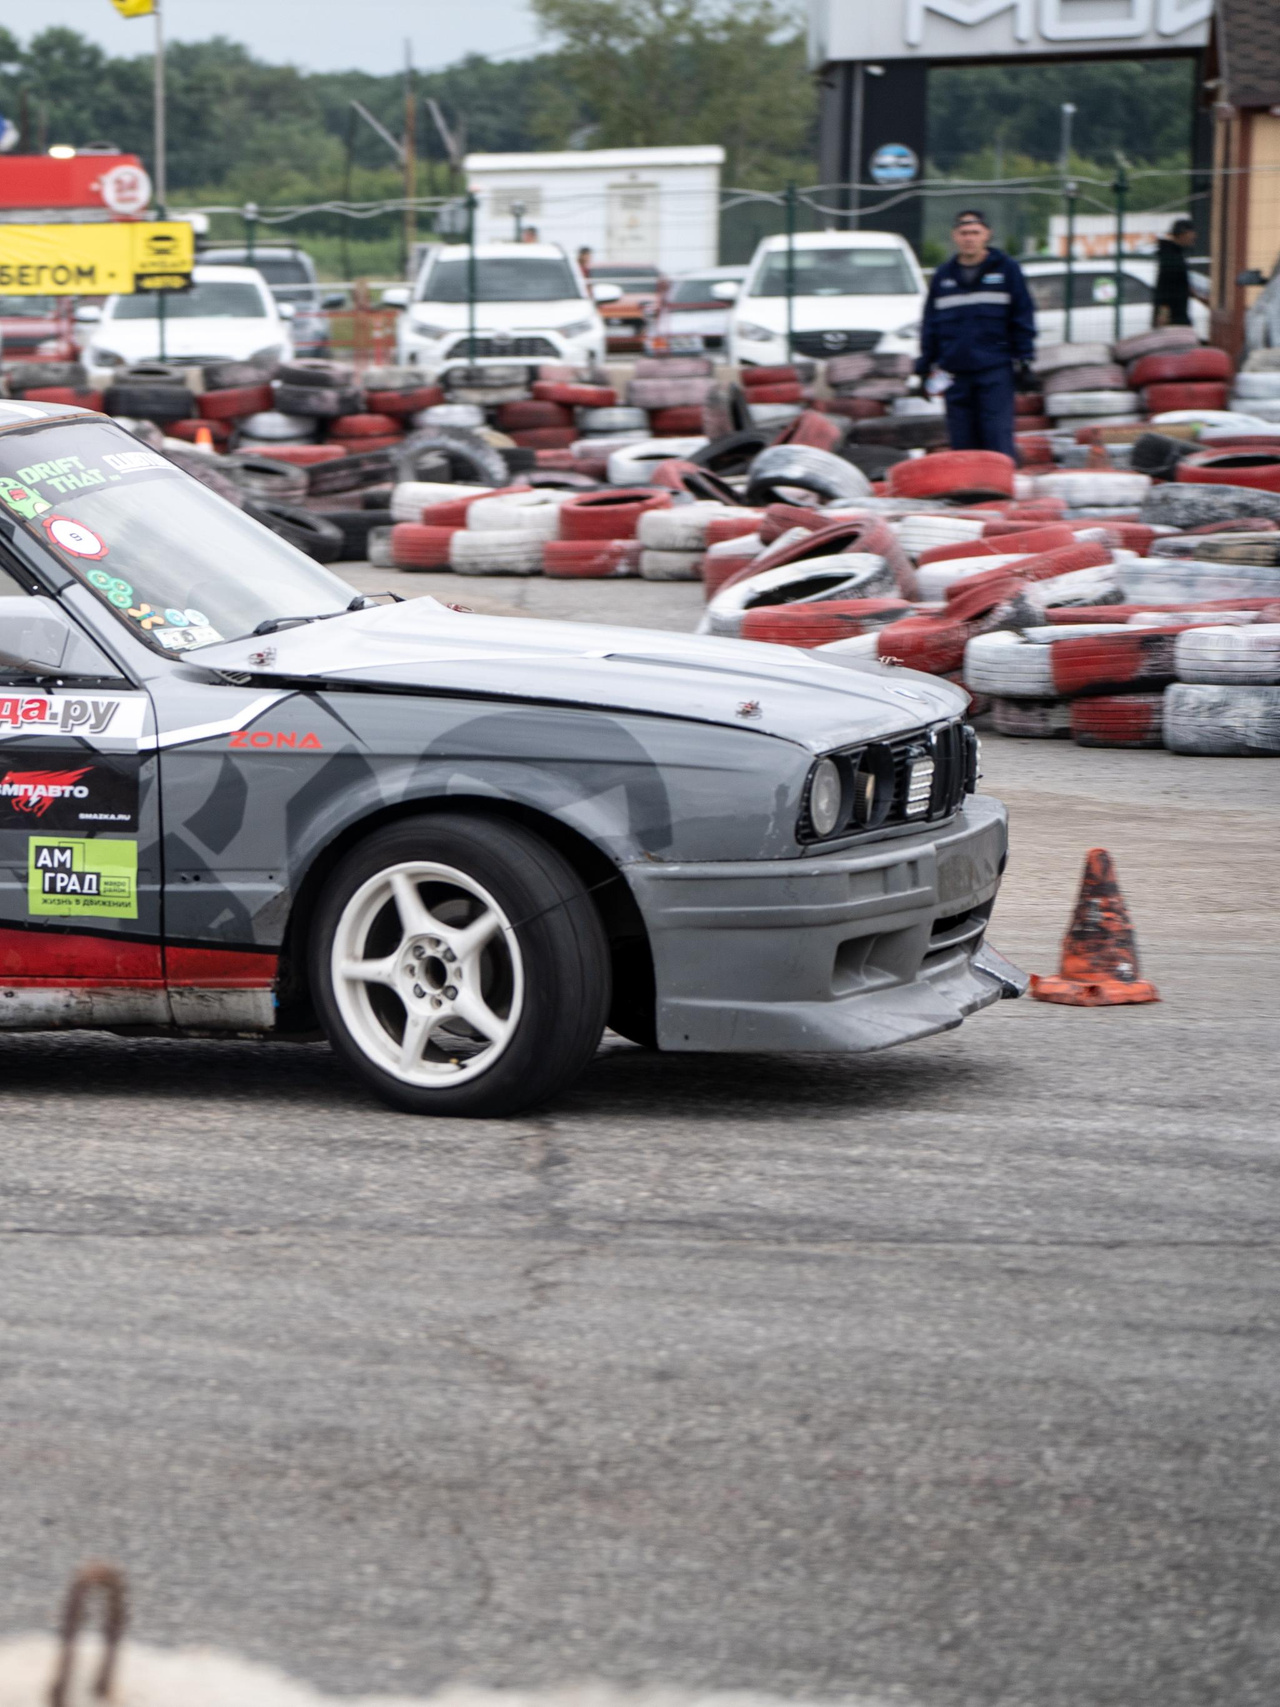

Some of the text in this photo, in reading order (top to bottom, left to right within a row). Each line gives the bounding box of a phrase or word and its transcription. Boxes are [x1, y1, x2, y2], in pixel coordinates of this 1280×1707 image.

[16, 456, 86, 485] DRIFT
[46, 469, 107, 493] THAT
[228, 731, 323, 749] ZONA
[37, 848, 72, 868] АМ
[44, 872, 99, 894] ГРАД
